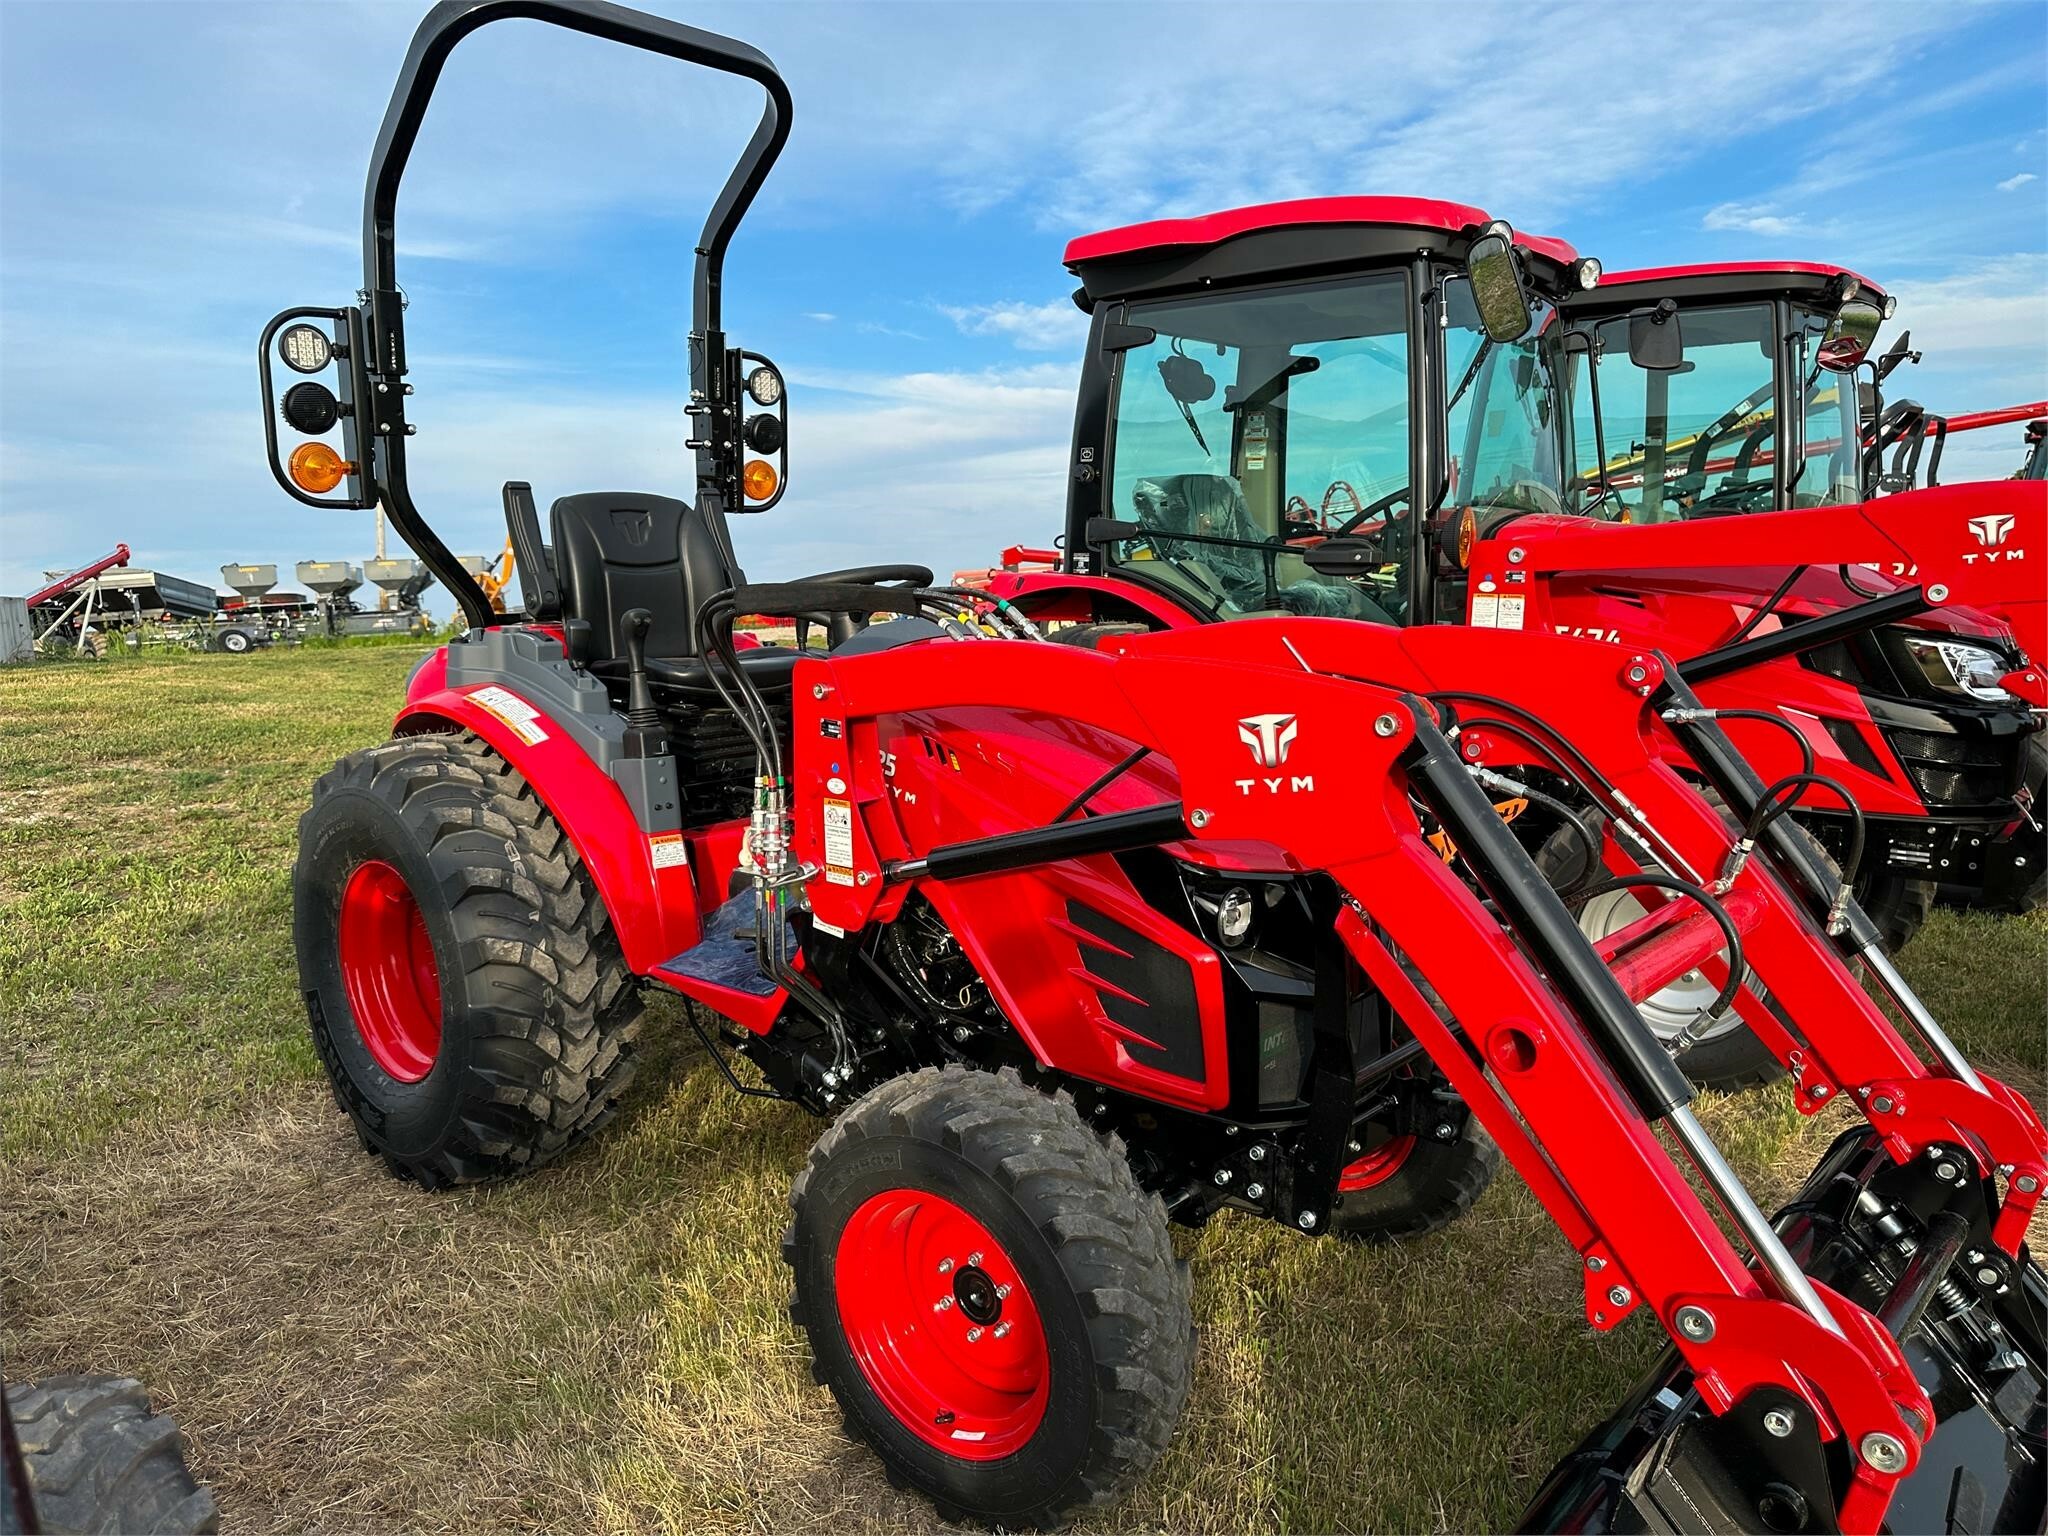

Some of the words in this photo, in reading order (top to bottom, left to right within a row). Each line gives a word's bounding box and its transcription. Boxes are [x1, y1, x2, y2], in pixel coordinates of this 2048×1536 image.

[1961, 549, 2024, 565] TYM
[885, 783, 917, 805] YM
[1234, 775, 1315, 796] TYM
